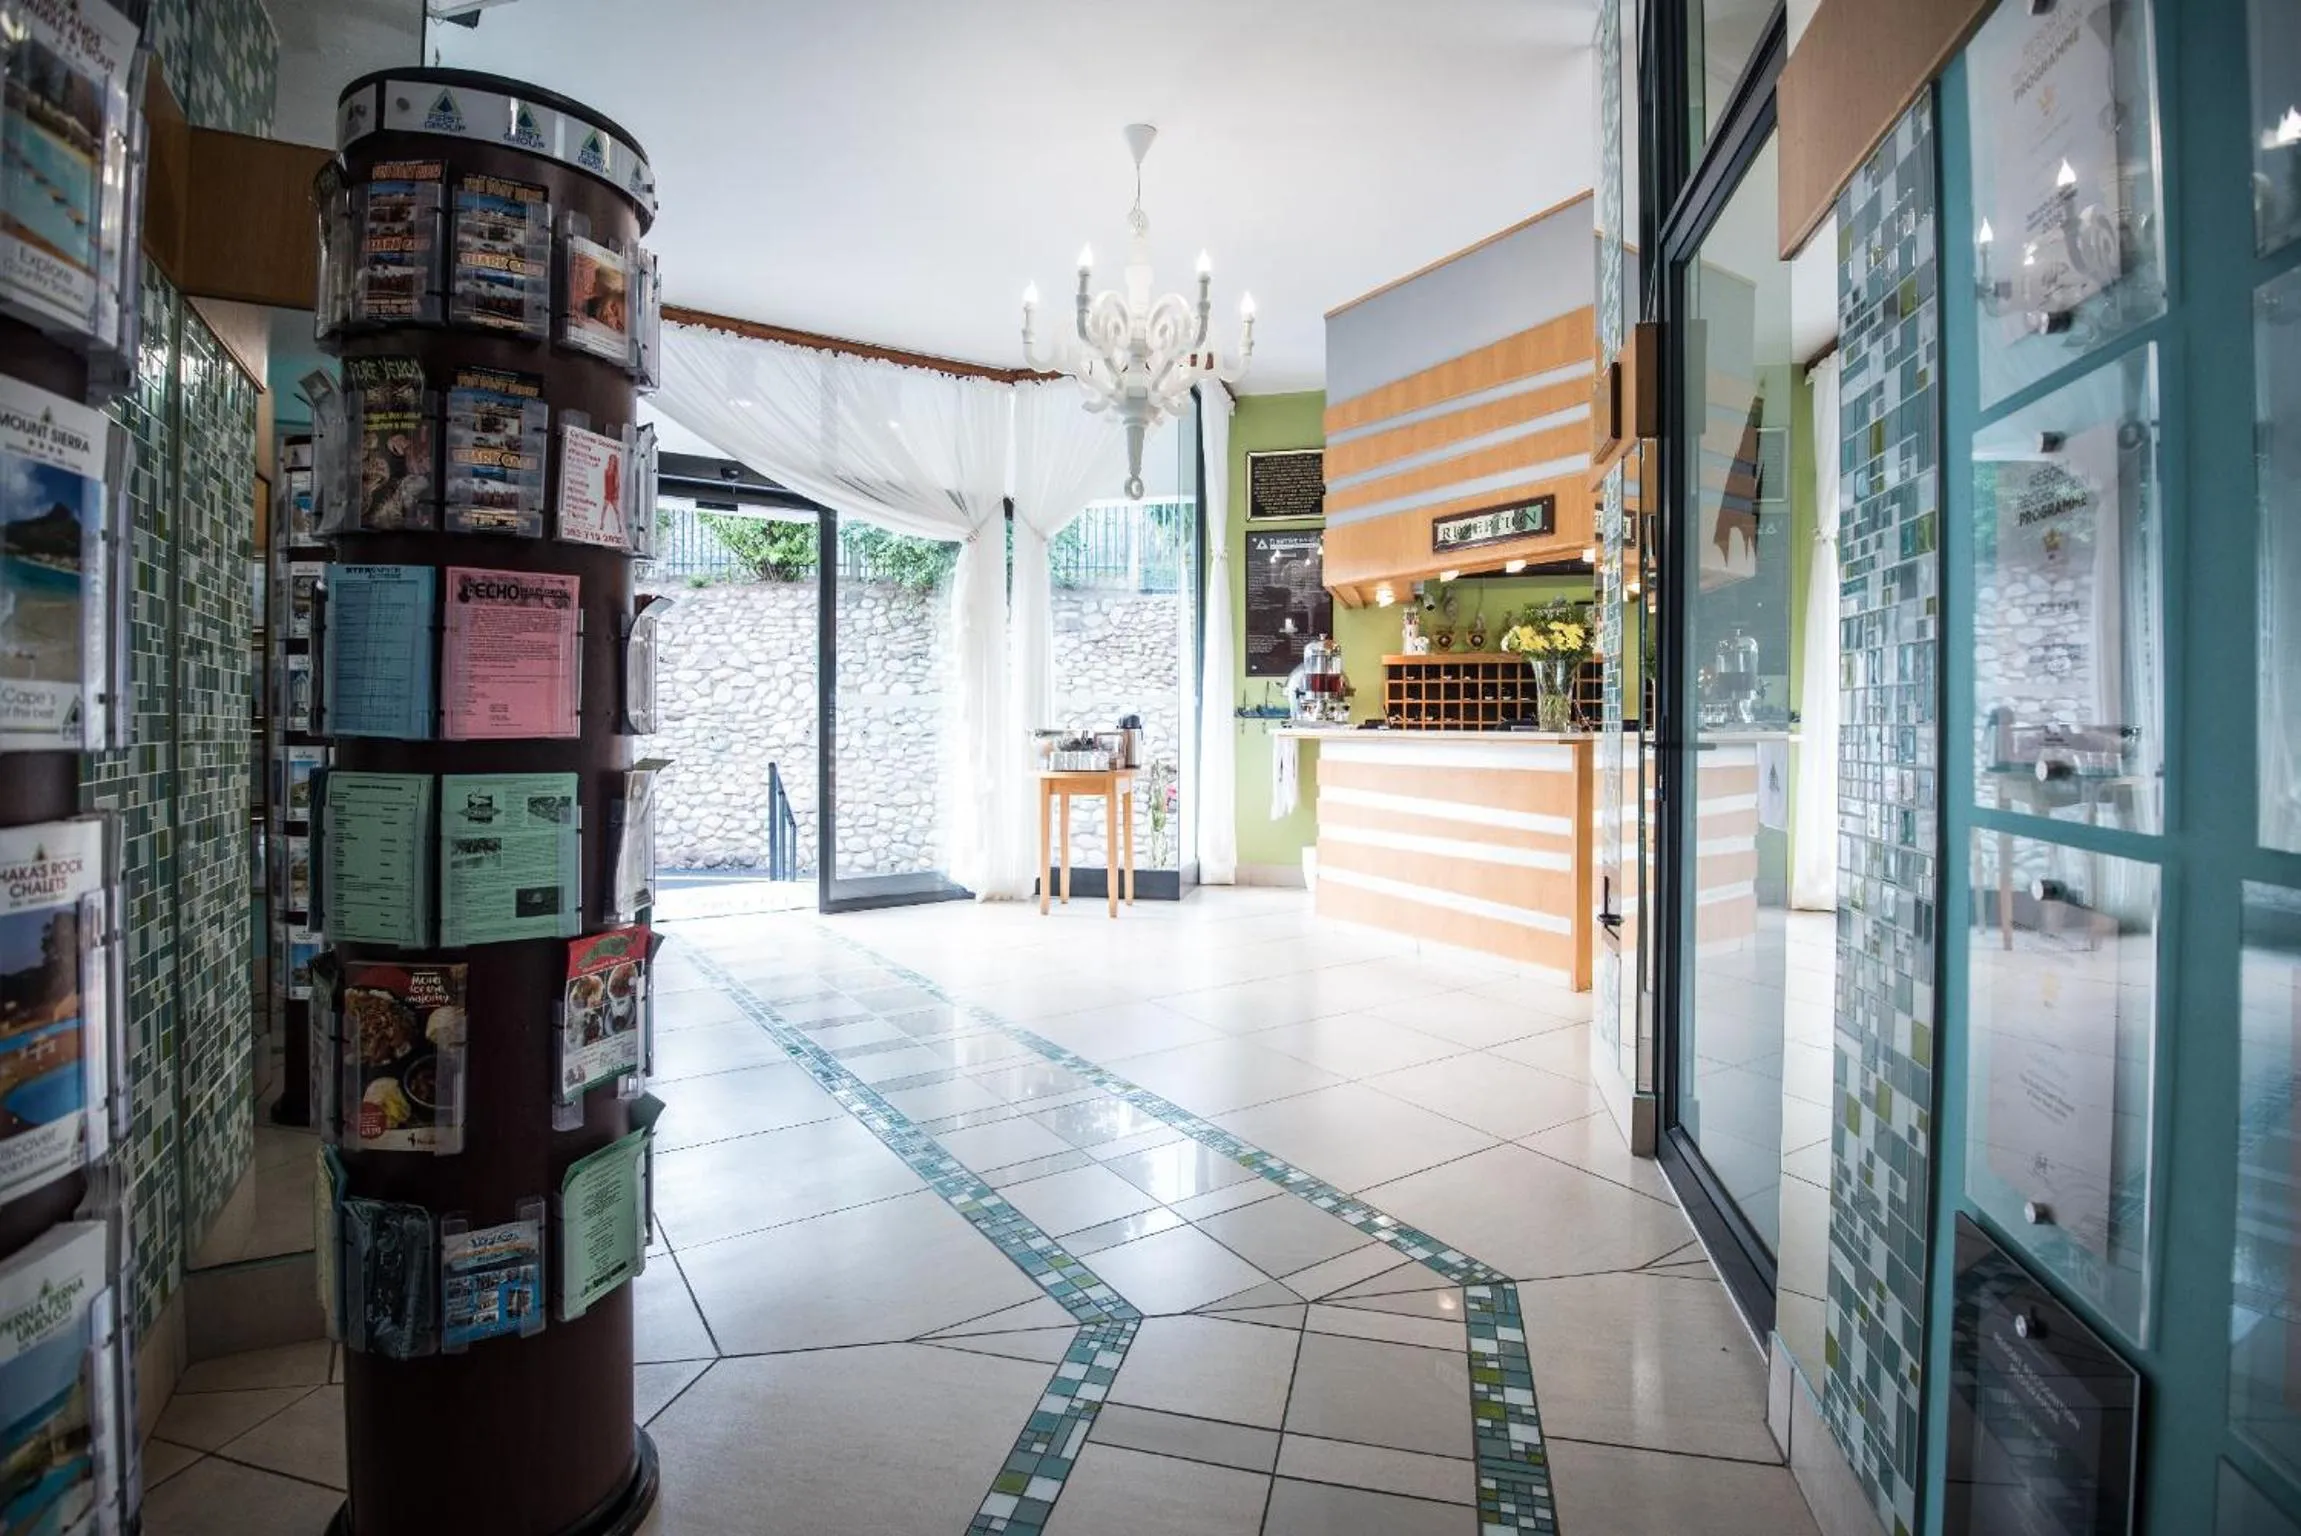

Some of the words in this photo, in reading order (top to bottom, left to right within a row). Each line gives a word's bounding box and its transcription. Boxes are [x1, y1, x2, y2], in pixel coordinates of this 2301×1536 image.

[424, 120, 466, 132] GROUP
[505, 126, 543, 142] FRST
[503, 134, 545, 150] GROUP
[0, 412, 49, 439] MOUNT
[51, 428, 90, 454] SIERRA
[2019, 492, 2087, 527] PROGRAMME
[476, 583, 520, 600] ECHO
[0, 861, 50, 882] HAKA'S
[51, 859, 83, 874] ROCK
[9, 877, 67, 898] CHALETS
